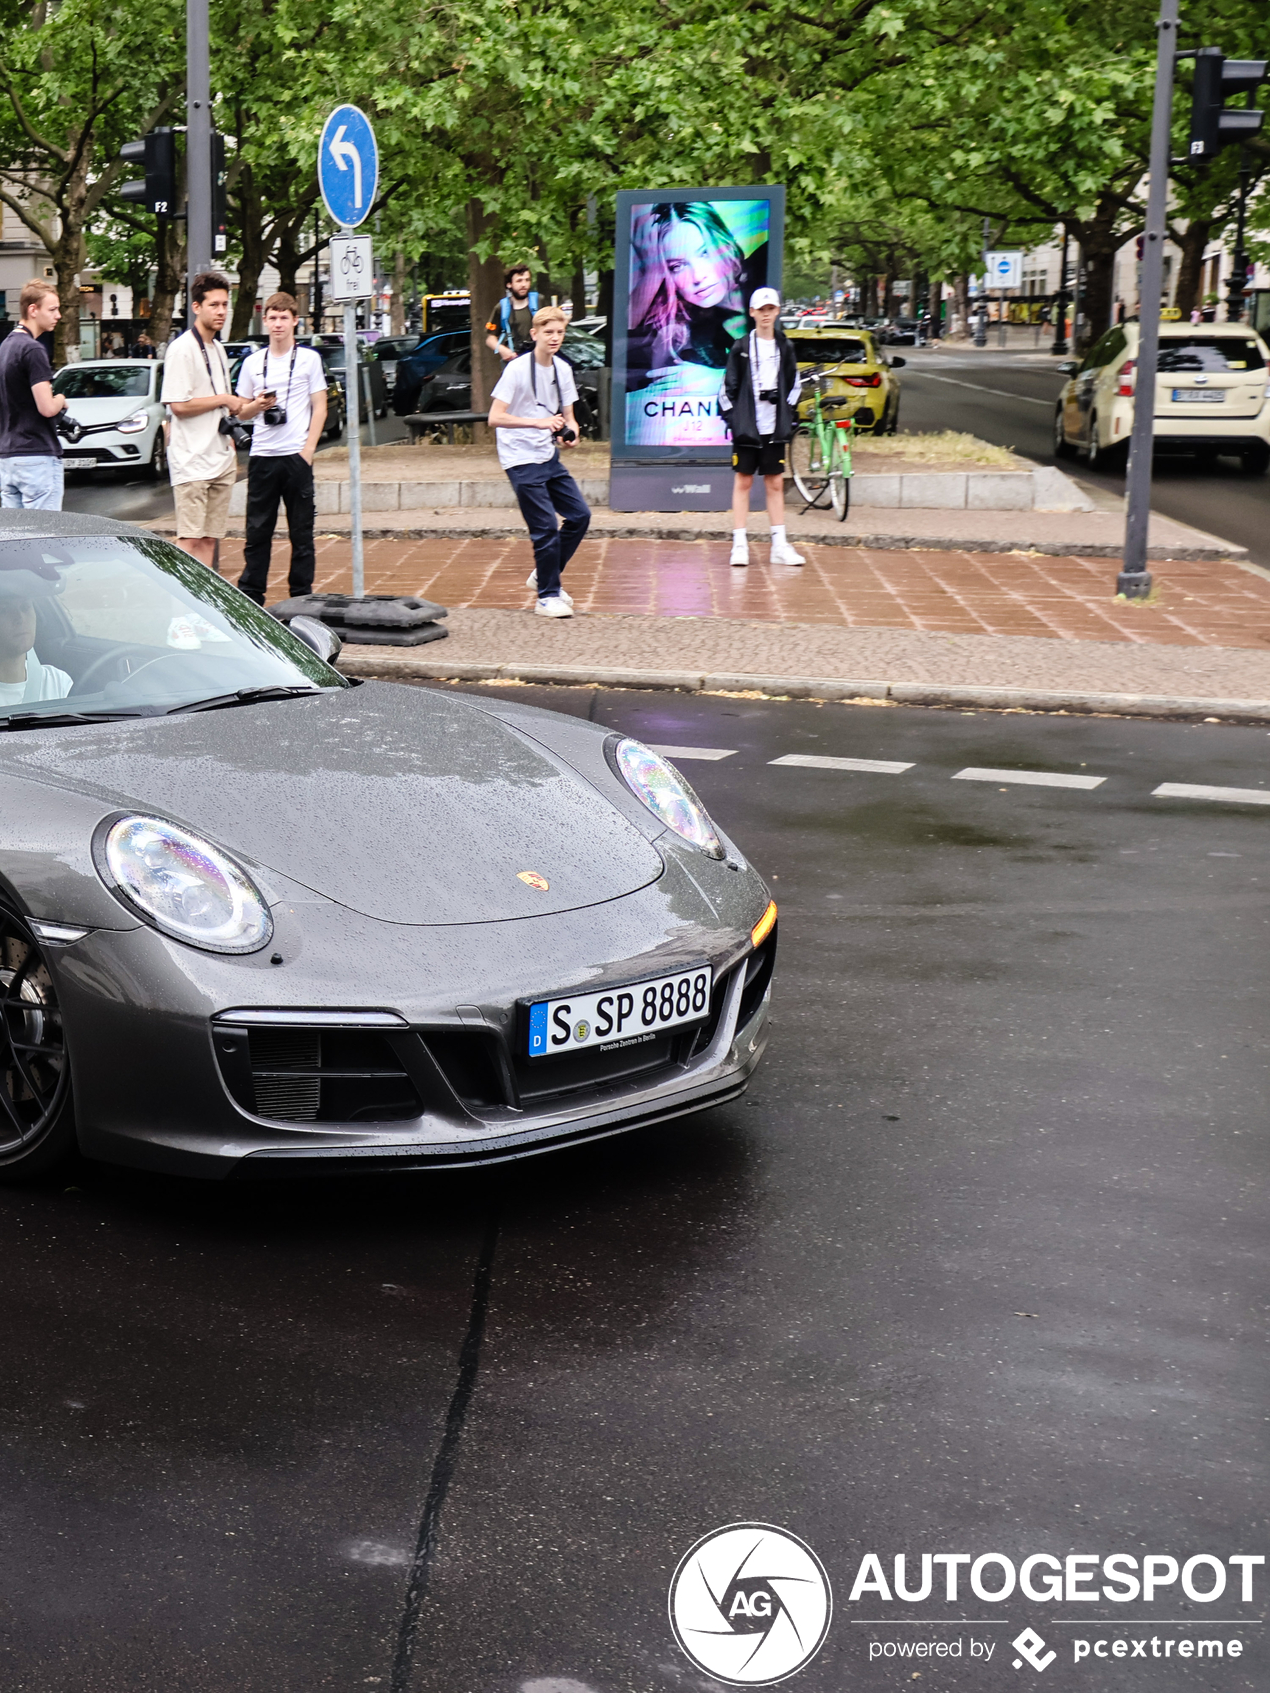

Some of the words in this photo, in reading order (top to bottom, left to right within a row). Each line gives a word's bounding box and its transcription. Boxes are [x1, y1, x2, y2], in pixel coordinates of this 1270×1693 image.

[154, 201, 168, 212] F2
[346, 278, 360, 291] frei
[644, 401, 721, 417] CHAN
[533, 1035, 542, 1047] D
[551, 1004, 572, 1045] S
[595, 992, 634, 1037] SP
[641, 973, 707, 1026] 8888
[600, 1042, 619, 1051] Porsche
[620, 1038, 637, 1048] Zentren
[643, 1033, 656, 1042] Berlin
